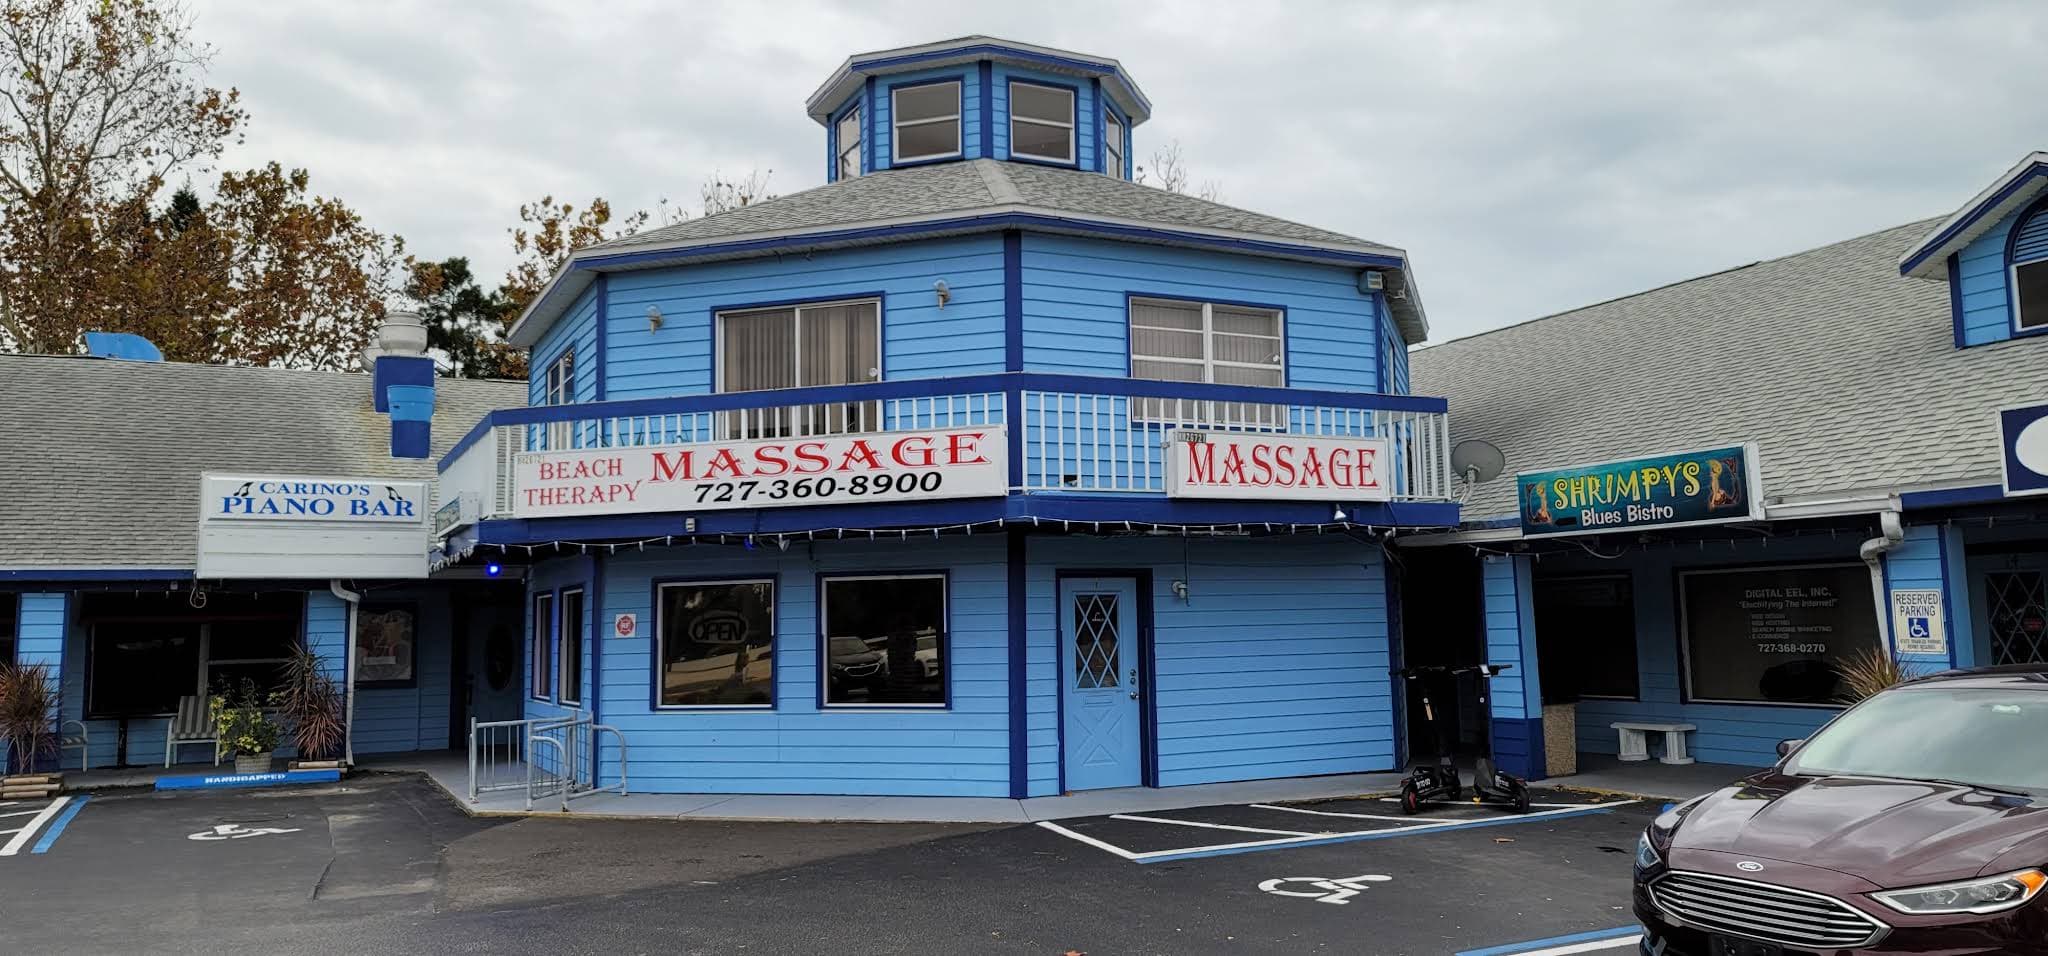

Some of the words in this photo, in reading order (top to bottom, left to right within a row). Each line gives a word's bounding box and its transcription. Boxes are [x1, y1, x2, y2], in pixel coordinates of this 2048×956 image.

[647, 432, 990, 482] MASSAGE
[1186, 441, 1381, 488] MASSAGE
[540, 458, 622, 480] BEACH
[259, 482, 370, 496] CARINO'S
[524, 480, 642, 506] THERAPY
[694, 471, 943, 503] 727-360-8900
[1553, 461, 1701, 510] SHRIMPYS
[221, 496, 335, 516] PIANO
[349, 499, 415, 517] BAR
[1581, 507, 1622, 527] Blues
[1627, 503, 1674, 523] Bistro
[1745, 589, 1783, 599] DIGITAL
[1786, 588, 1808, 598] EEL,
[1810, 587, 1832, 597] INC.
[1896, 593, 1939, 605] RESERVED
[1785, 600, 1800, 608] The
[1900, 605, 1936, 617] PARKING
[692, 621, 744, 641] OPEN
[1757, 643, 1826, 653] 727-368-0270
[205, 773, 286, 784] HANDICAPPED
